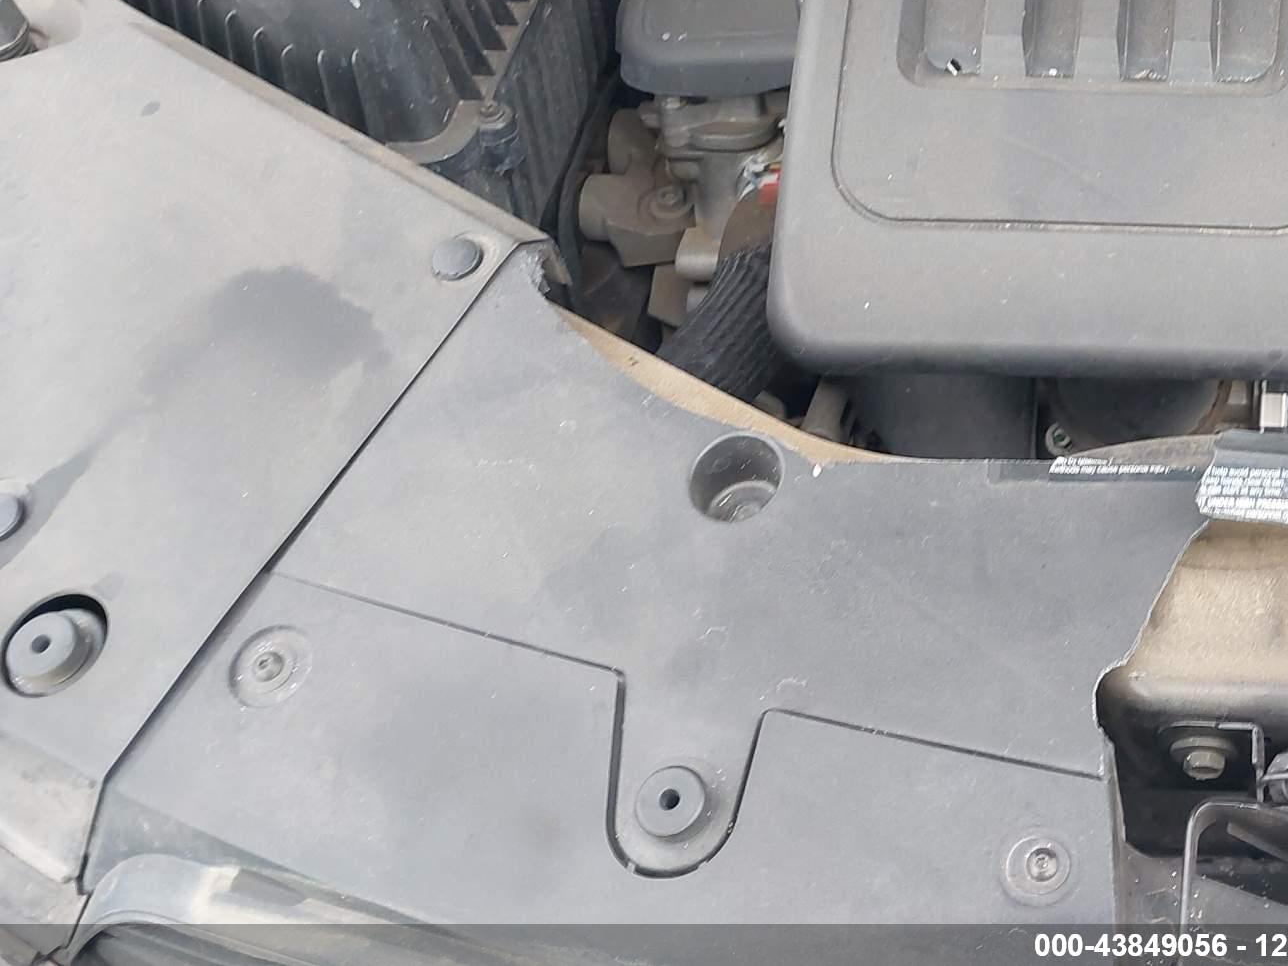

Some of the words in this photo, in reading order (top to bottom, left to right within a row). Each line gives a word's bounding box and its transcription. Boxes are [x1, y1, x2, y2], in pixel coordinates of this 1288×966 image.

[1097, 465, 1118, 474] cause
[1118, 465, 1149, 475] personal
[1229, 467, 1249, 477] avoid
[1249, 468, 1280, 479] personal
[1207, 497, 1235, 509] UNDER
[1235, 498, 1256, 509] HIGH
